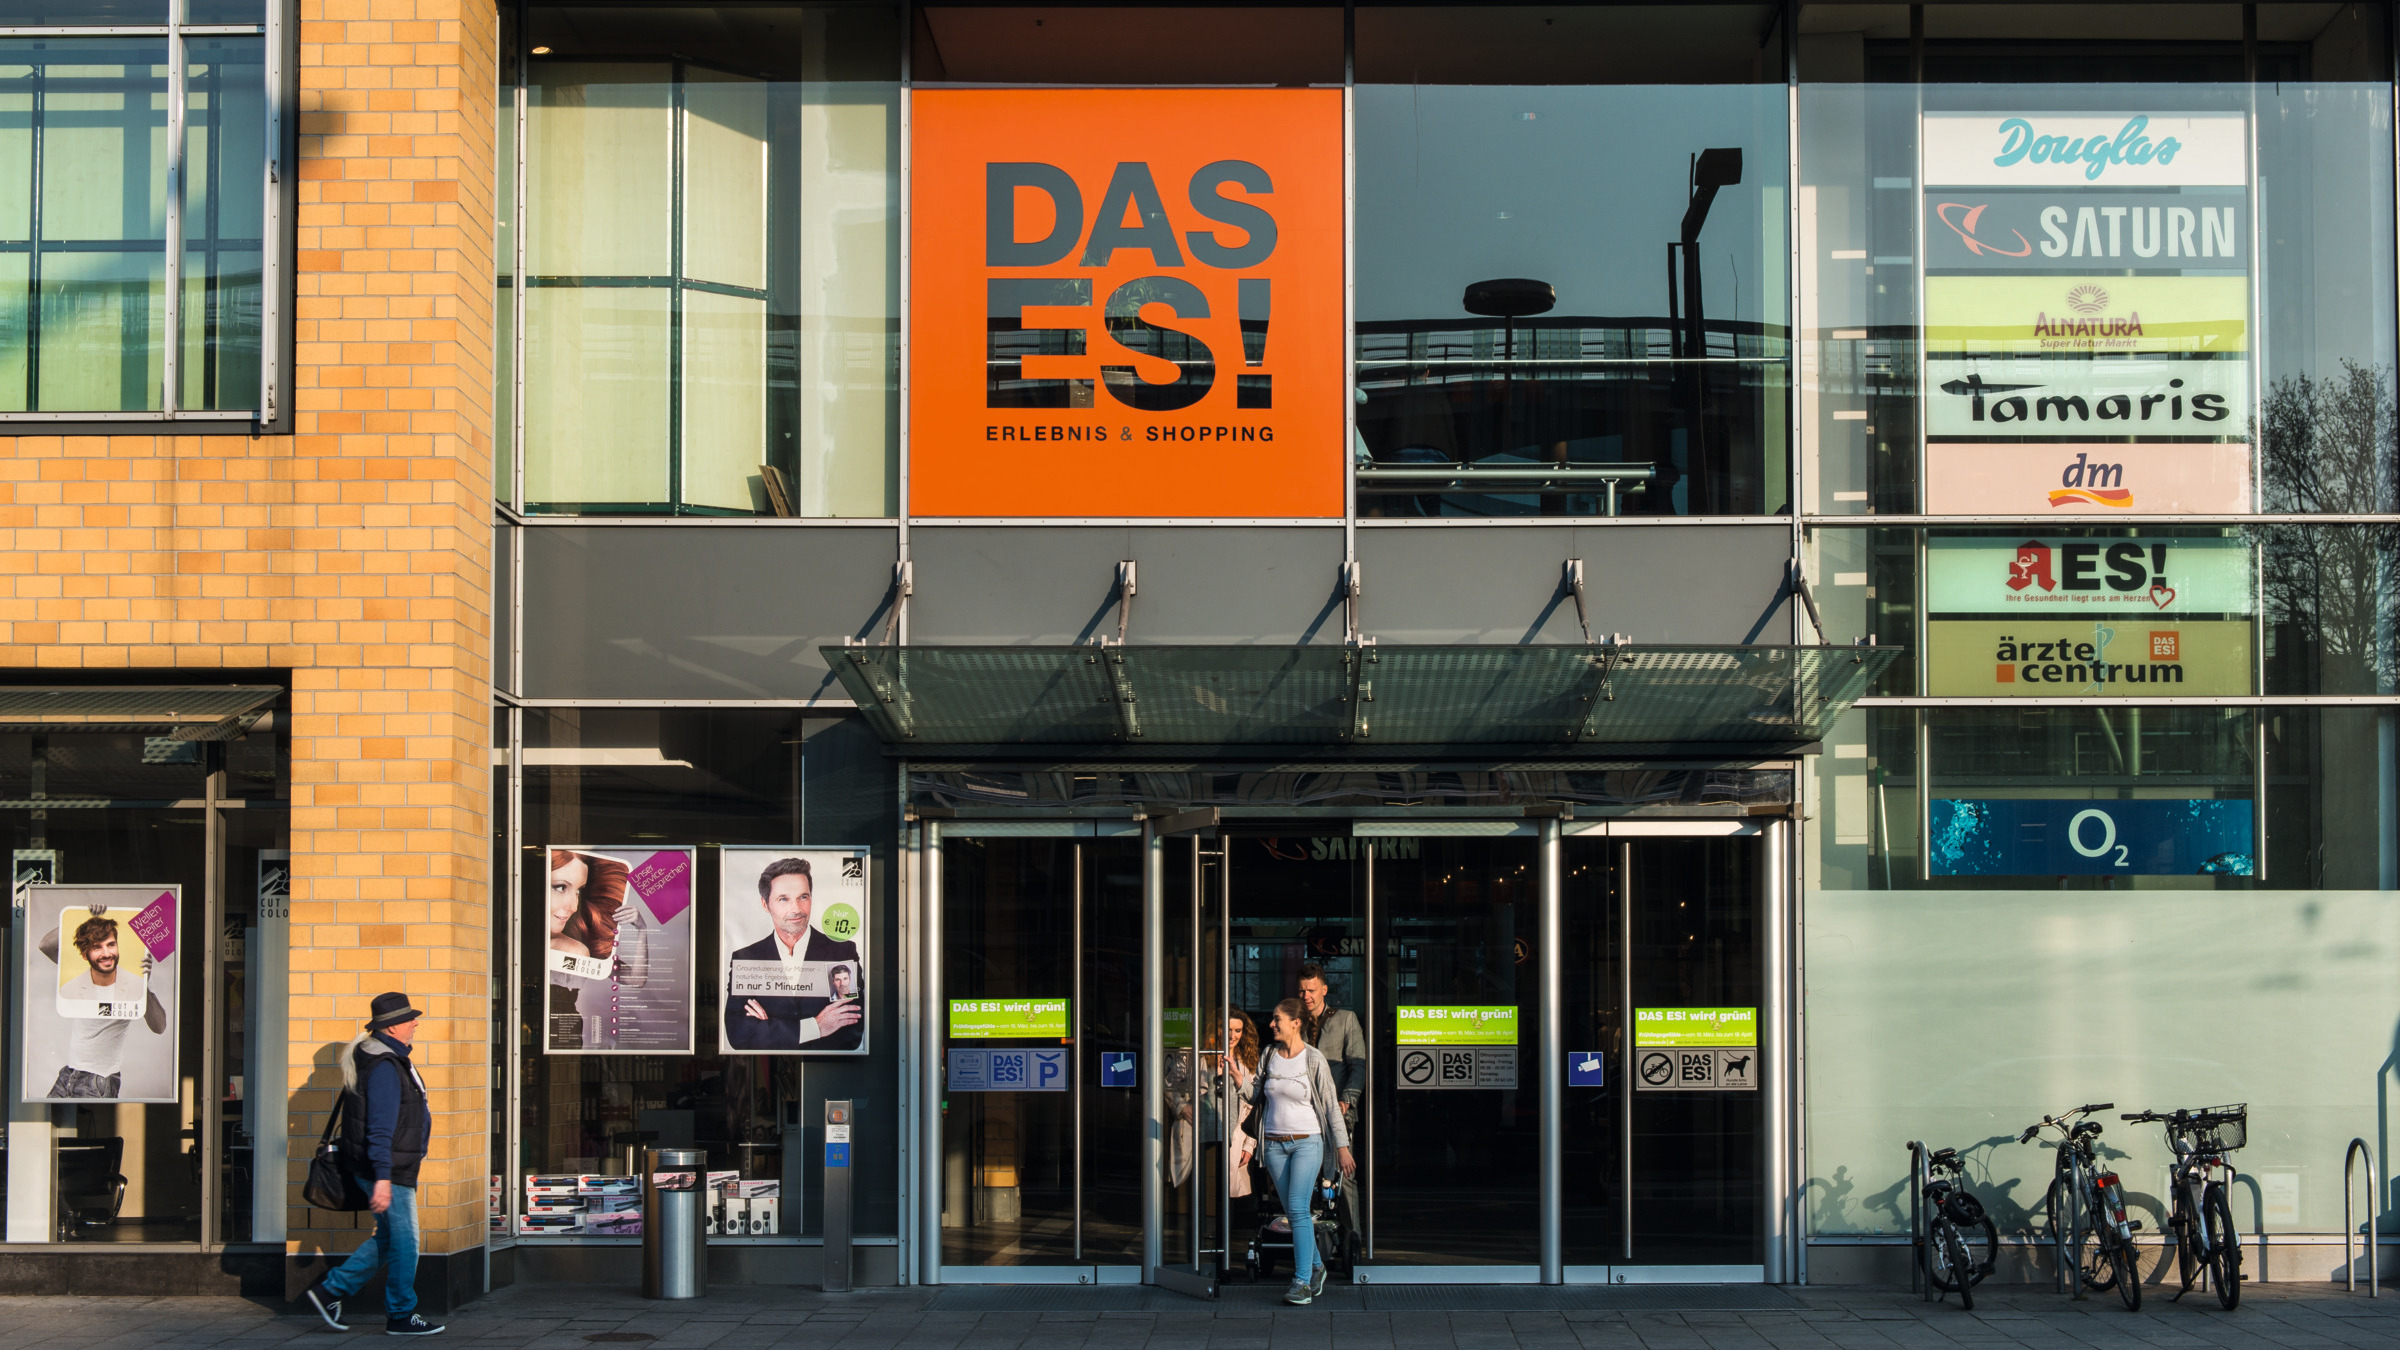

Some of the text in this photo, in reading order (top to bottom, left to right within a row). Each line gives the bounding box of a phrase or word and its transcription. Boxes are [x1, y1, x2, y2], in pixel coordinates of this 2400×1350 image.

[1993, 114, 2182, 181] Douglas
[985, 159, 1279, 270] DAS
[2039, 205, 2235, 258] SATURN
[2033, 311, 2144, 337] ALNATURA
[986, 275, 1273, 412] ES!
[2040, 338, 2137, 349] Super Natur Markt
[985, 425, 1275, 442] ERLEBNIS & SHOPPING
[2062, 452, 2123, 488] dm
[2062, 542, 2167, 592] ES!
[2006, 594, 2021, 602] Ihre
[2024, 594, 2069, 602] Gesundheit
[2071, 594, 2089, 603] liegt
[2123, 594, 2151, 602] Herzen
[2153, 636, 2175, 645] DAS
[1996, 635, 2096, 662] ärzte
[2153, 645, 2175, 655] ES!
[2021, 659, 2184, 683] centrum
[631, 864, 654, 884] Unser
[260, 898, 281, 908] CUT
[131, 905, 163, 930] Wellen
[260, 908, 289, 918] COLO
[833, 910, 848, 918] Nur
[138, 916, 164, 939] Reiter
[145, 926, 171, 949] Frisur
[1340, 938, 1399, 955] SATN
[735, 982, 744, 990] in
[765, 982, 772, 990] 5
[775, 982, 813, 991] Minuten!
[953, 1002, 1066, 1014] DAS ES! wird grün!
[1400, 1009, 1513, 1021] DAS ES! wird grün!
[1639, 1011, 1751, 1023] DAS ES! wird grün!
[993, 1054, 1024, 1067] DAS
[1443, 1052, 1472, 1065] DAS
[1682, 1053, 1712, 1066] DAS
[993, 1066, 1024, 1082] ES!
[1443, 1064, 1472, 1079] ES!
[1682, 1066, 1712, 1081] ES!
